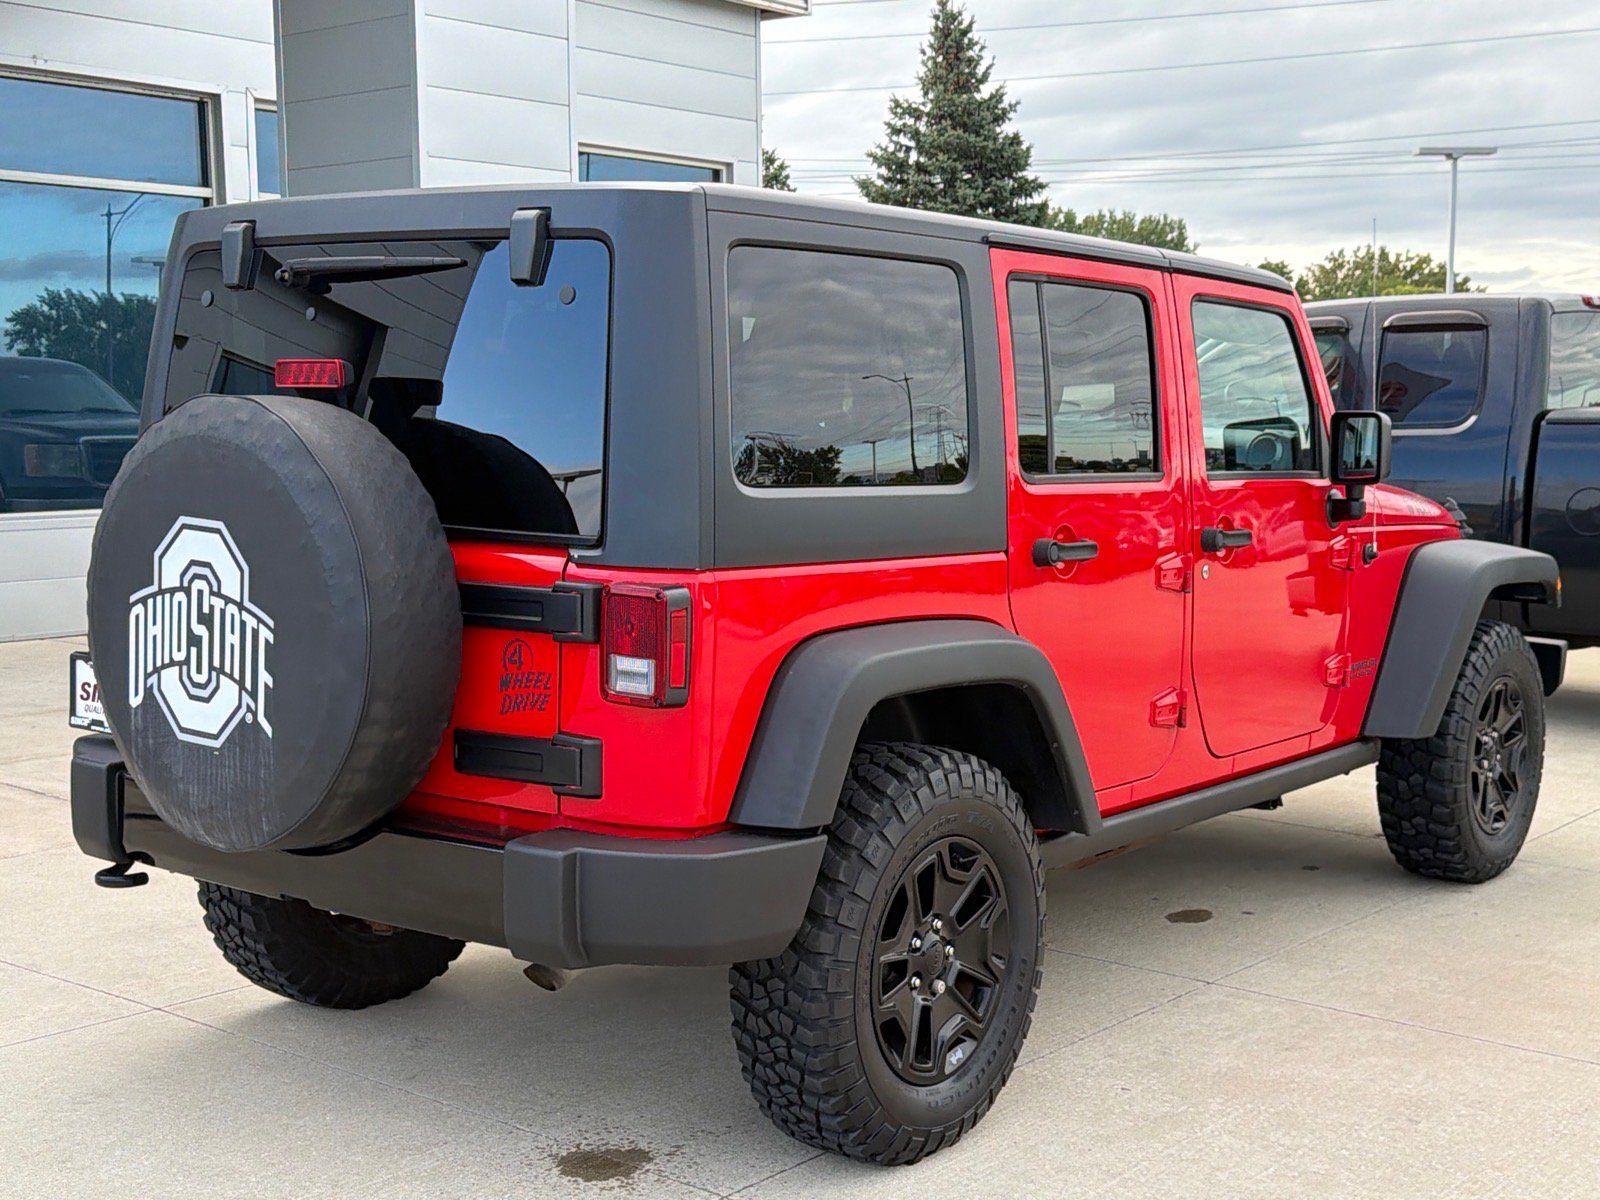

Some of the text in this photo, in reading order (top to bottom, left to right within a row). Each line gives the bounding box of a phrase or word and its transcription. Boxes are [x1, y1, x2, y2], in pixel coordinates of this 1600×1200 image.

[509, 644, 523, 669] 4
[499, 671, 552, 692] WHEEL
[84, 704, 105, 716] QUALI
[501, 692, 551, 714] DRIVE
